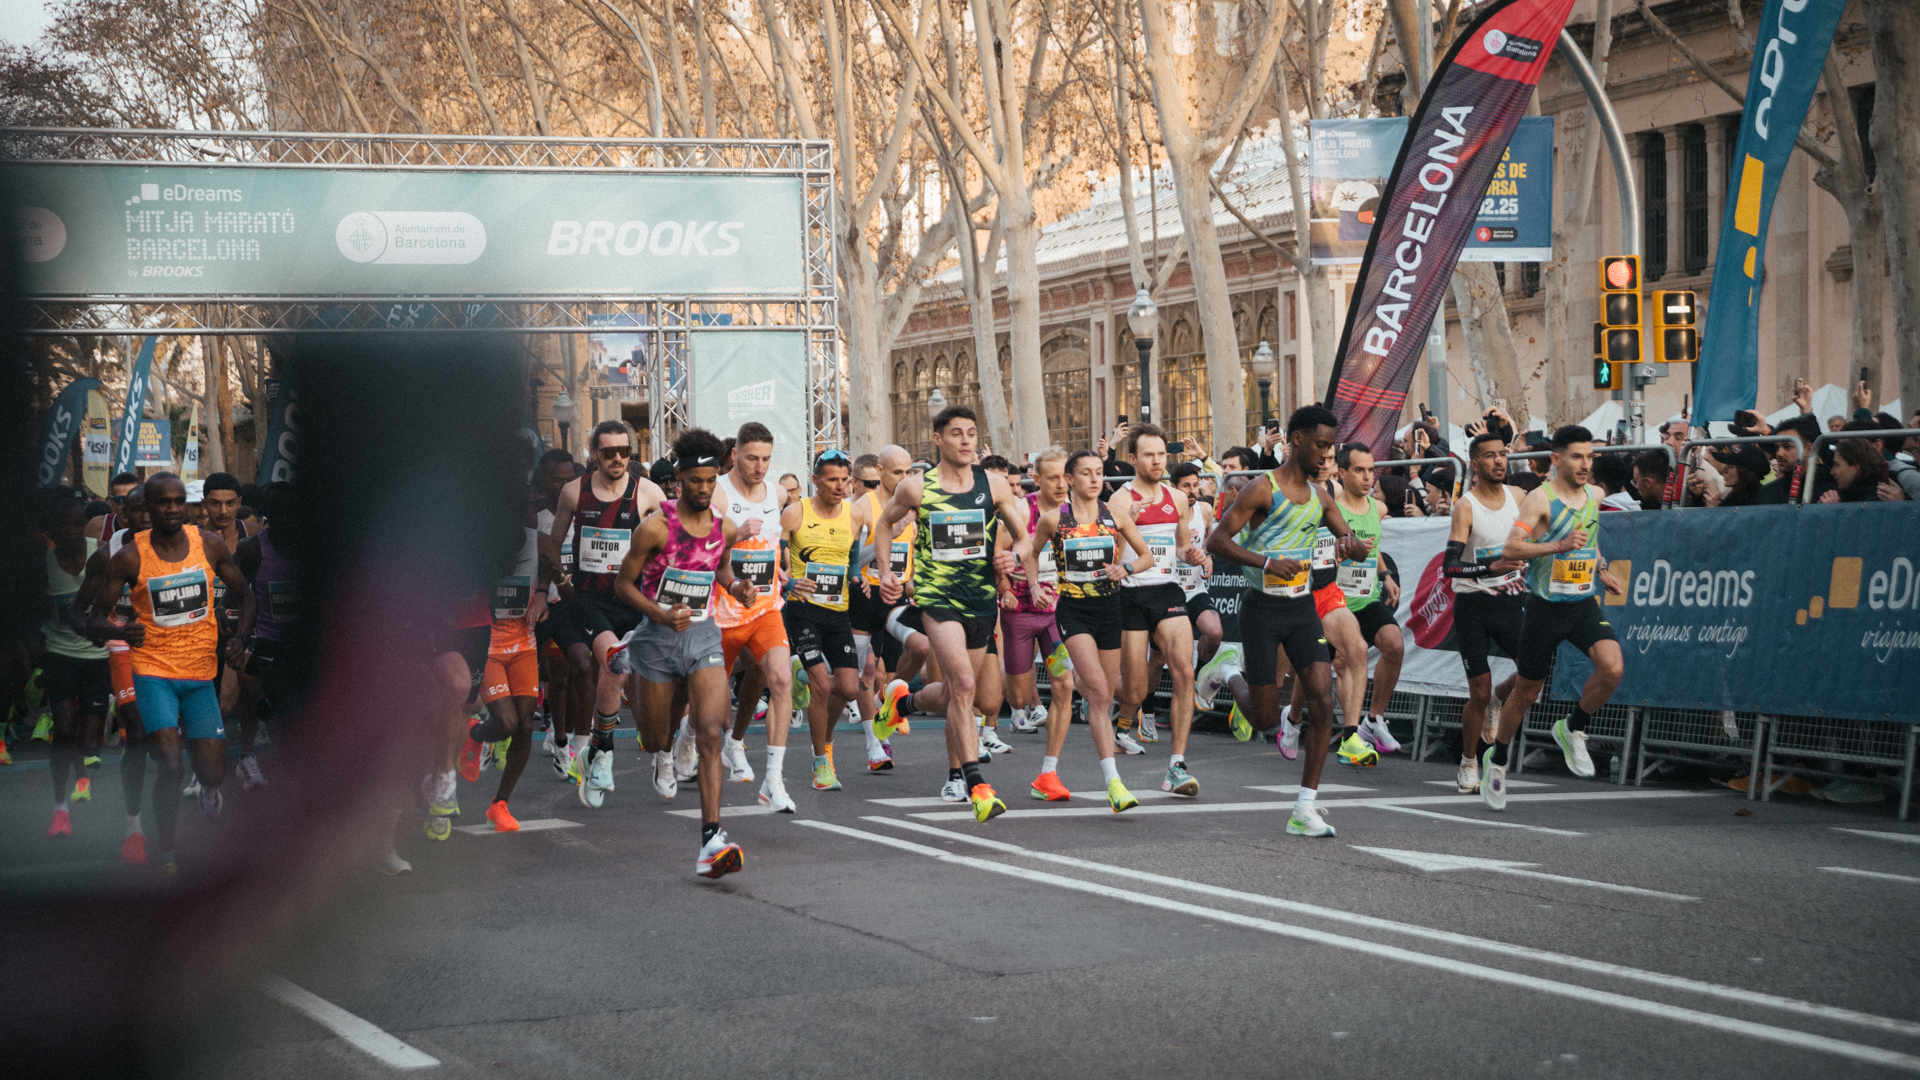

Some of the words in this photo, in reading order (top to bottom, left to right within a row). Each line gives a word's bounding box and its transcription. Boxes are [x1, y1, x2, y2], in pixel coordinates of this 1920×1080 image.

[1327, 130, 1356, 138] eDreams
[1314, 149, 1359, 159] BARCELONA
[1509, 163, 1527, 179] DE
[163, 184, 243, 201] eDreams
[125, 210, 194, 233] MITJA
[204, 207, 295, 234] MARATÓ
[394, 224, 451, 235] Ajuntament
[453, 225, 465, 233] de
[1363, 105, 1474, 357] BARCELONA
[395, 236, 466, 248] Barcelona
[546, 220, 745, 256] BROOKS
[126, 238, 260, 261] BARCELONA
[128, 269, 139, 278] by
[142, 266, 205, 277] BROOKS
[729, 384, 772, 402] FINISHER
[947, 524, 969, 536] PHIL
[591, 540, 619, 551] VICTOR
[1151, 547, 1166, 555] SJUR
[1076, 549, 1105, 561] SHONA
[742, 563, 767, 574] SCOTT
[1568, 561, 1587, 571] ALEX
[1351, 567, 1367, 578] IVÁN
[171, 576, 195, 585] eDreams
[816, 574, 838, 585] PACER
[1633, 559, 1755, 607] eDreams
[158, 584, 201, 602] KIPLIMO
[497, 587, 517, 597] ABDI
[664, 580, 709, 597] MAHAMED
[179, 600, 185, 608] 1
[1627, 616, 1692, 654] viajamos
[1698, 617, 1748, 658] contigo
[1861, 621, 1920, 663] viajam
